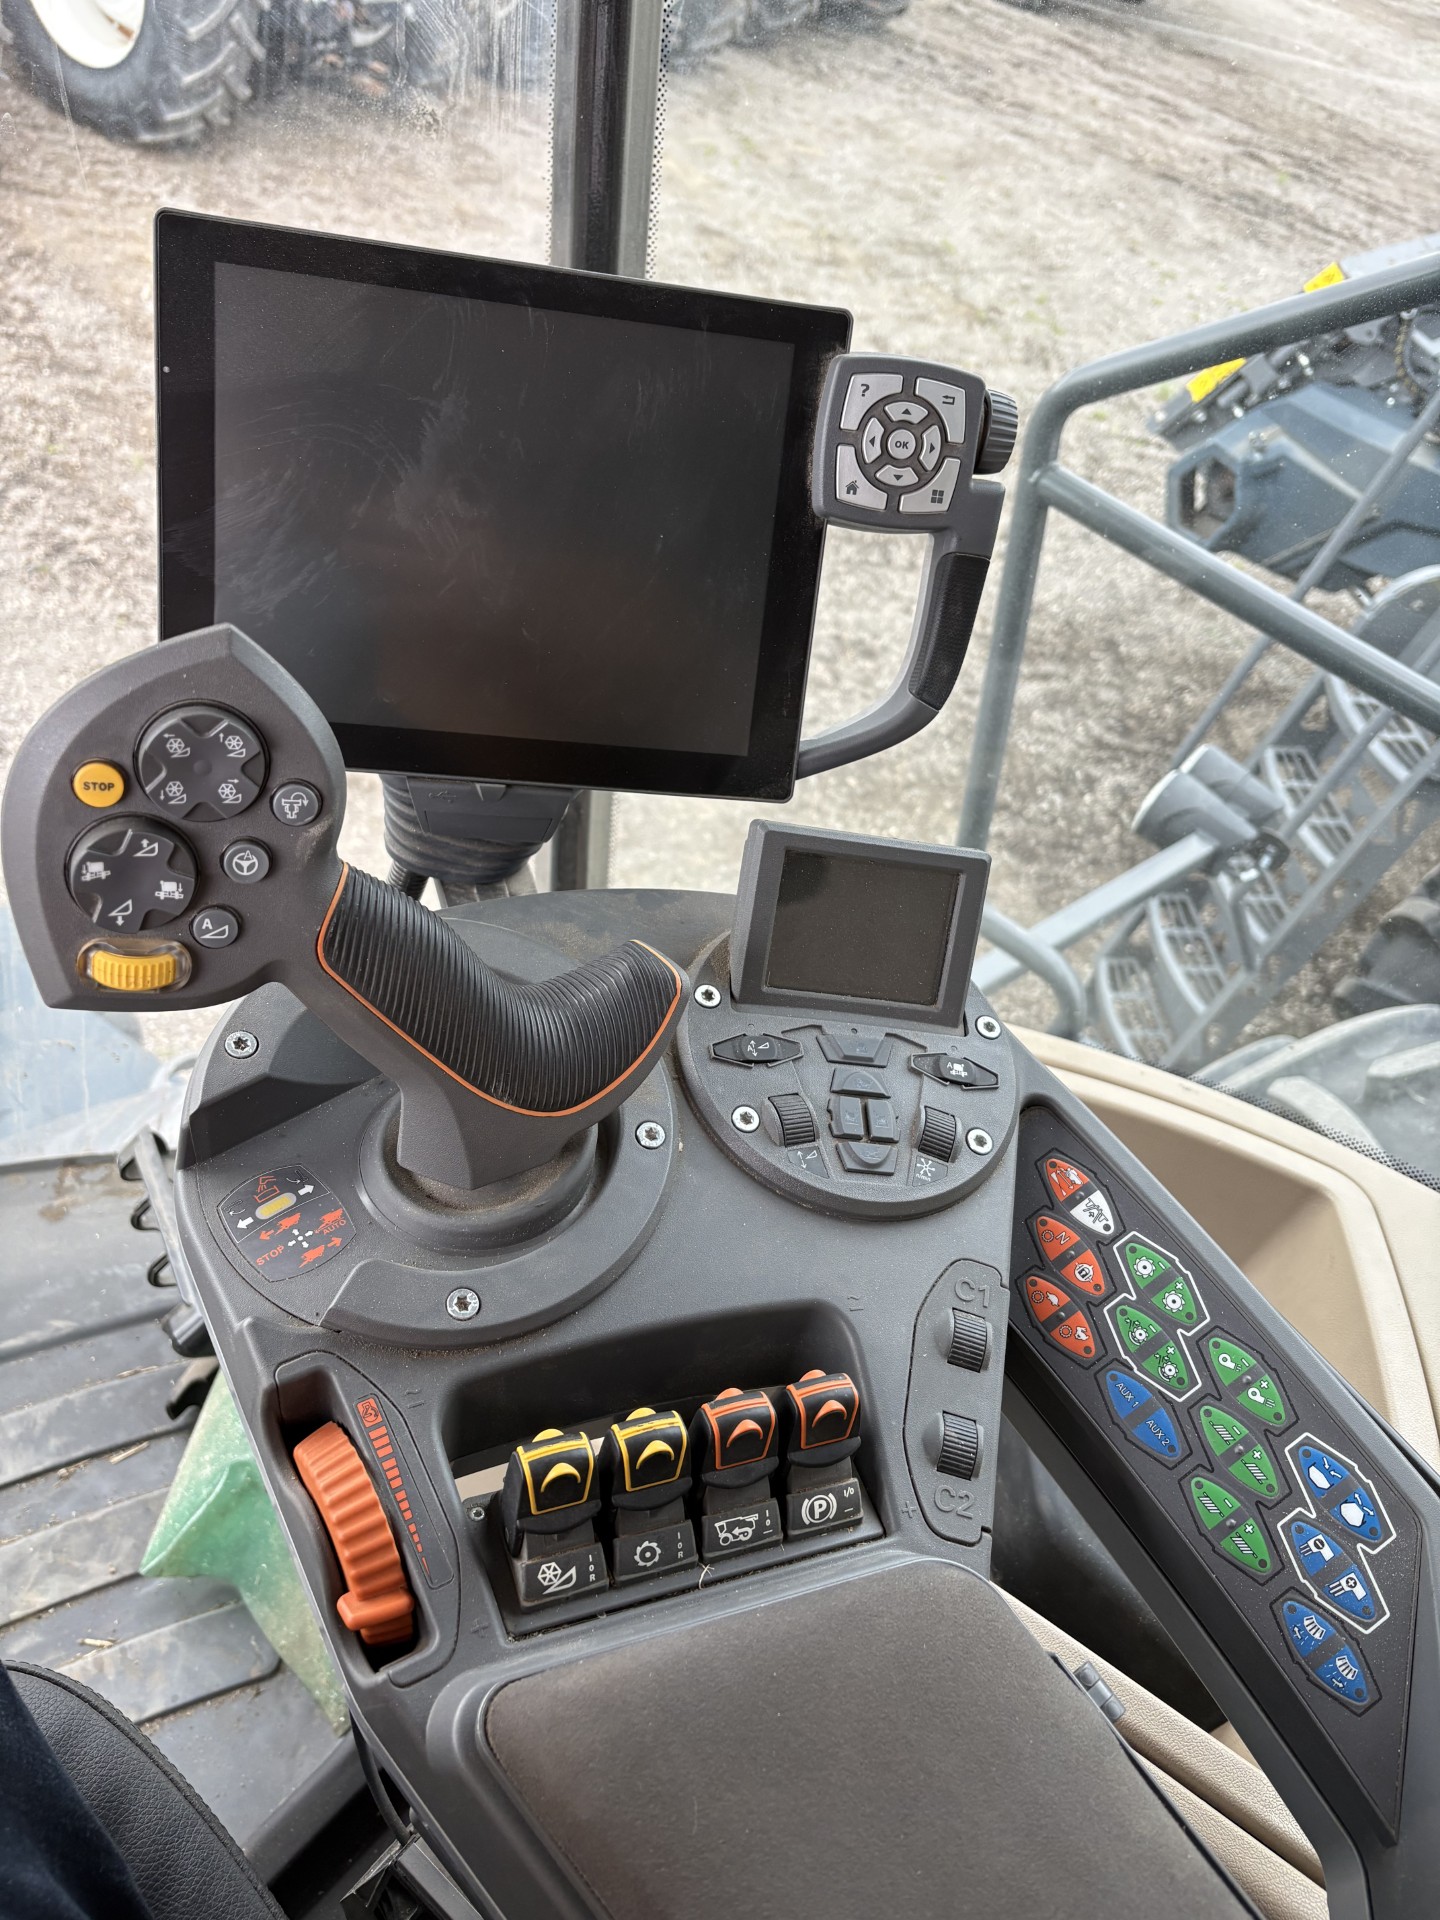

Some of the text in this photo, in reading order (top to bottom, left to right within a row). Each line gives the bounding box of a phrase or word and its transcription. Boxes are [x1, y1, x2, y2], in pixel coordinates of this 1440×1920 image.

[860, 383, 870, 397] ?
[894, 440, 909, 451] OK
[83, 781, 115, 792] STOP
[243, 850, 253, 861] A
[202, 918, 213, 930] A
[946, 1062, 954, 1070] A
[323, 1219, 346, 1236] AUTO
[1055, 1231, 1071, 1246] N
[256, 1245, 285, 1266] STOP
[954, 1278, 991, 1309] C1
[1116, 1382, 1140, 1409] AUX 1
[1146, 1420, 1170, 1447] AUX 2
[933, 1484, 975, 1520] C2
[813, 1500, 828, 1520] P
[676, 1551, 684, 1559] R
[588, 1573, 596, 1582] R
